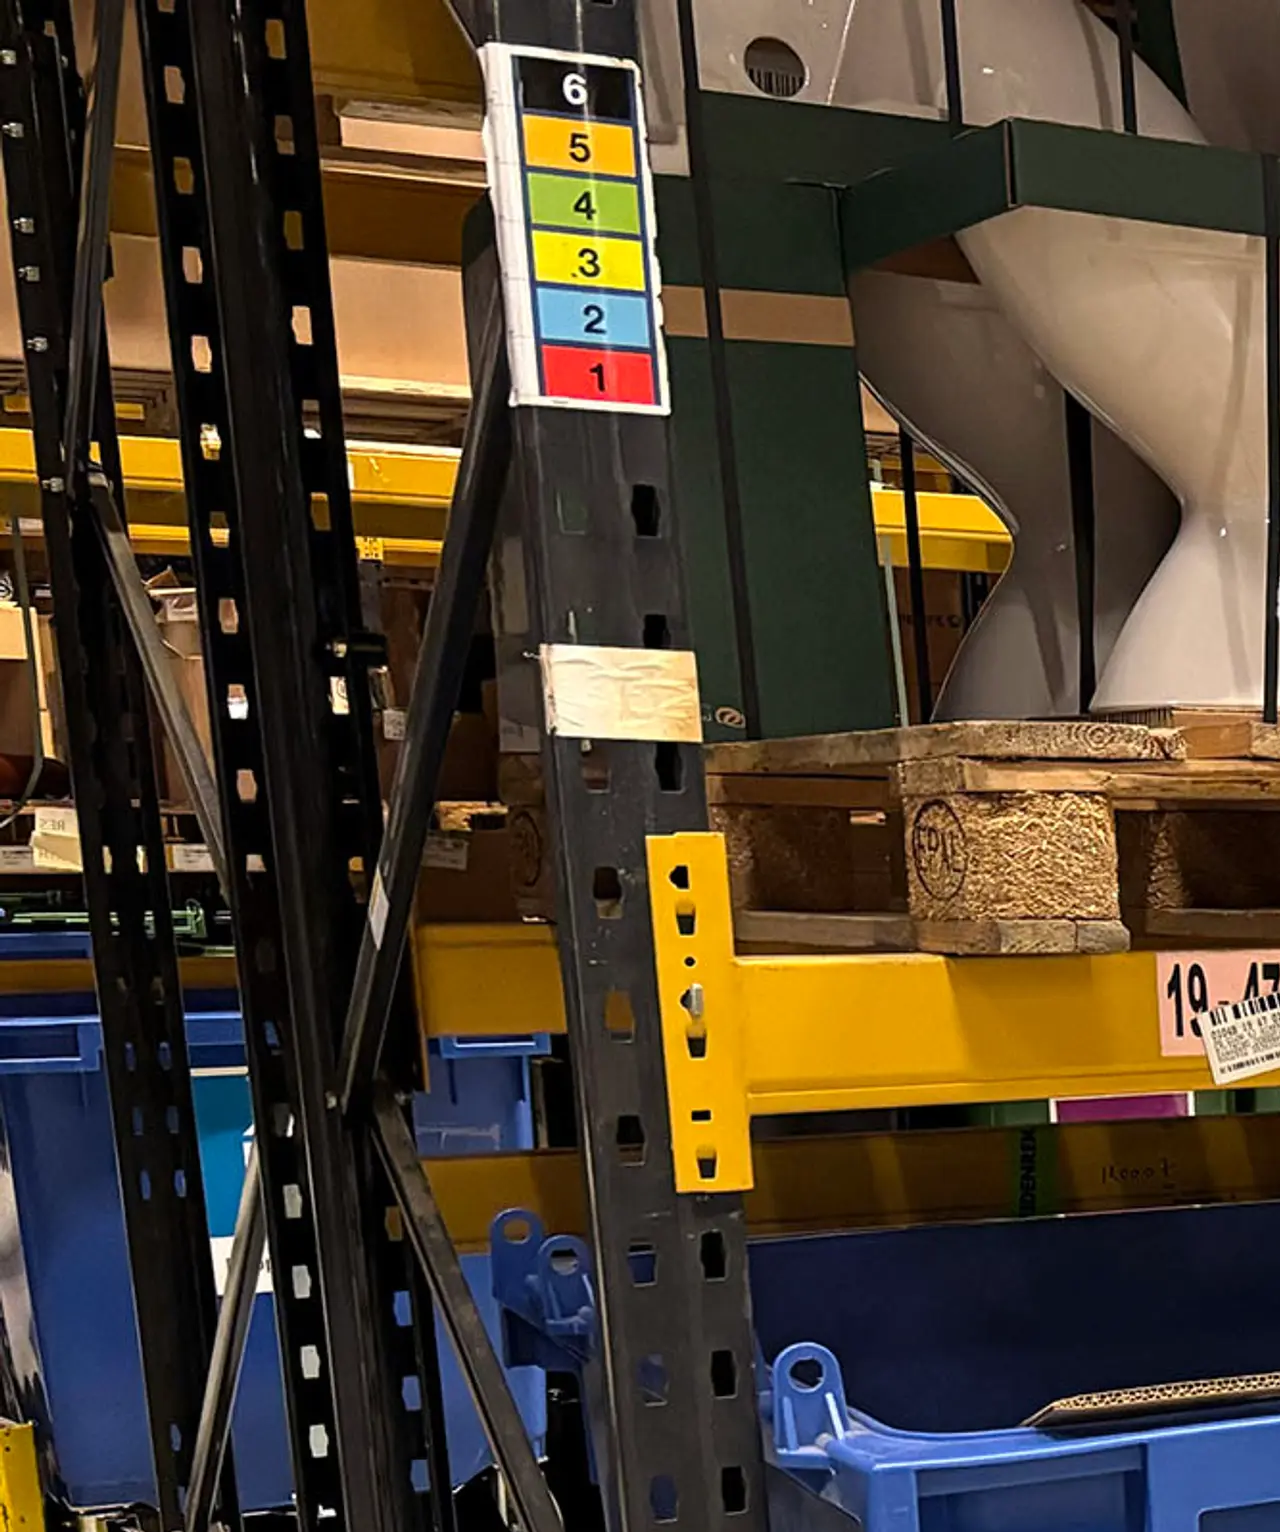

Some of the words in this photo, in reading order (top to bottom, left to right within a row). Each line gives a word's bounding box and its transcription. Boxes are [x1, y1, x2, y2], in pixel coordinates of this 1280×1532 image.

[563, 74, 587, 105] 6
[570, 133, 590, 162] 5
[573, 191, 595, 220] 4
[578, 248, 600, 277] 3
[584, 305, 605, 334] 2
[589, 363, 605, 392] 1
